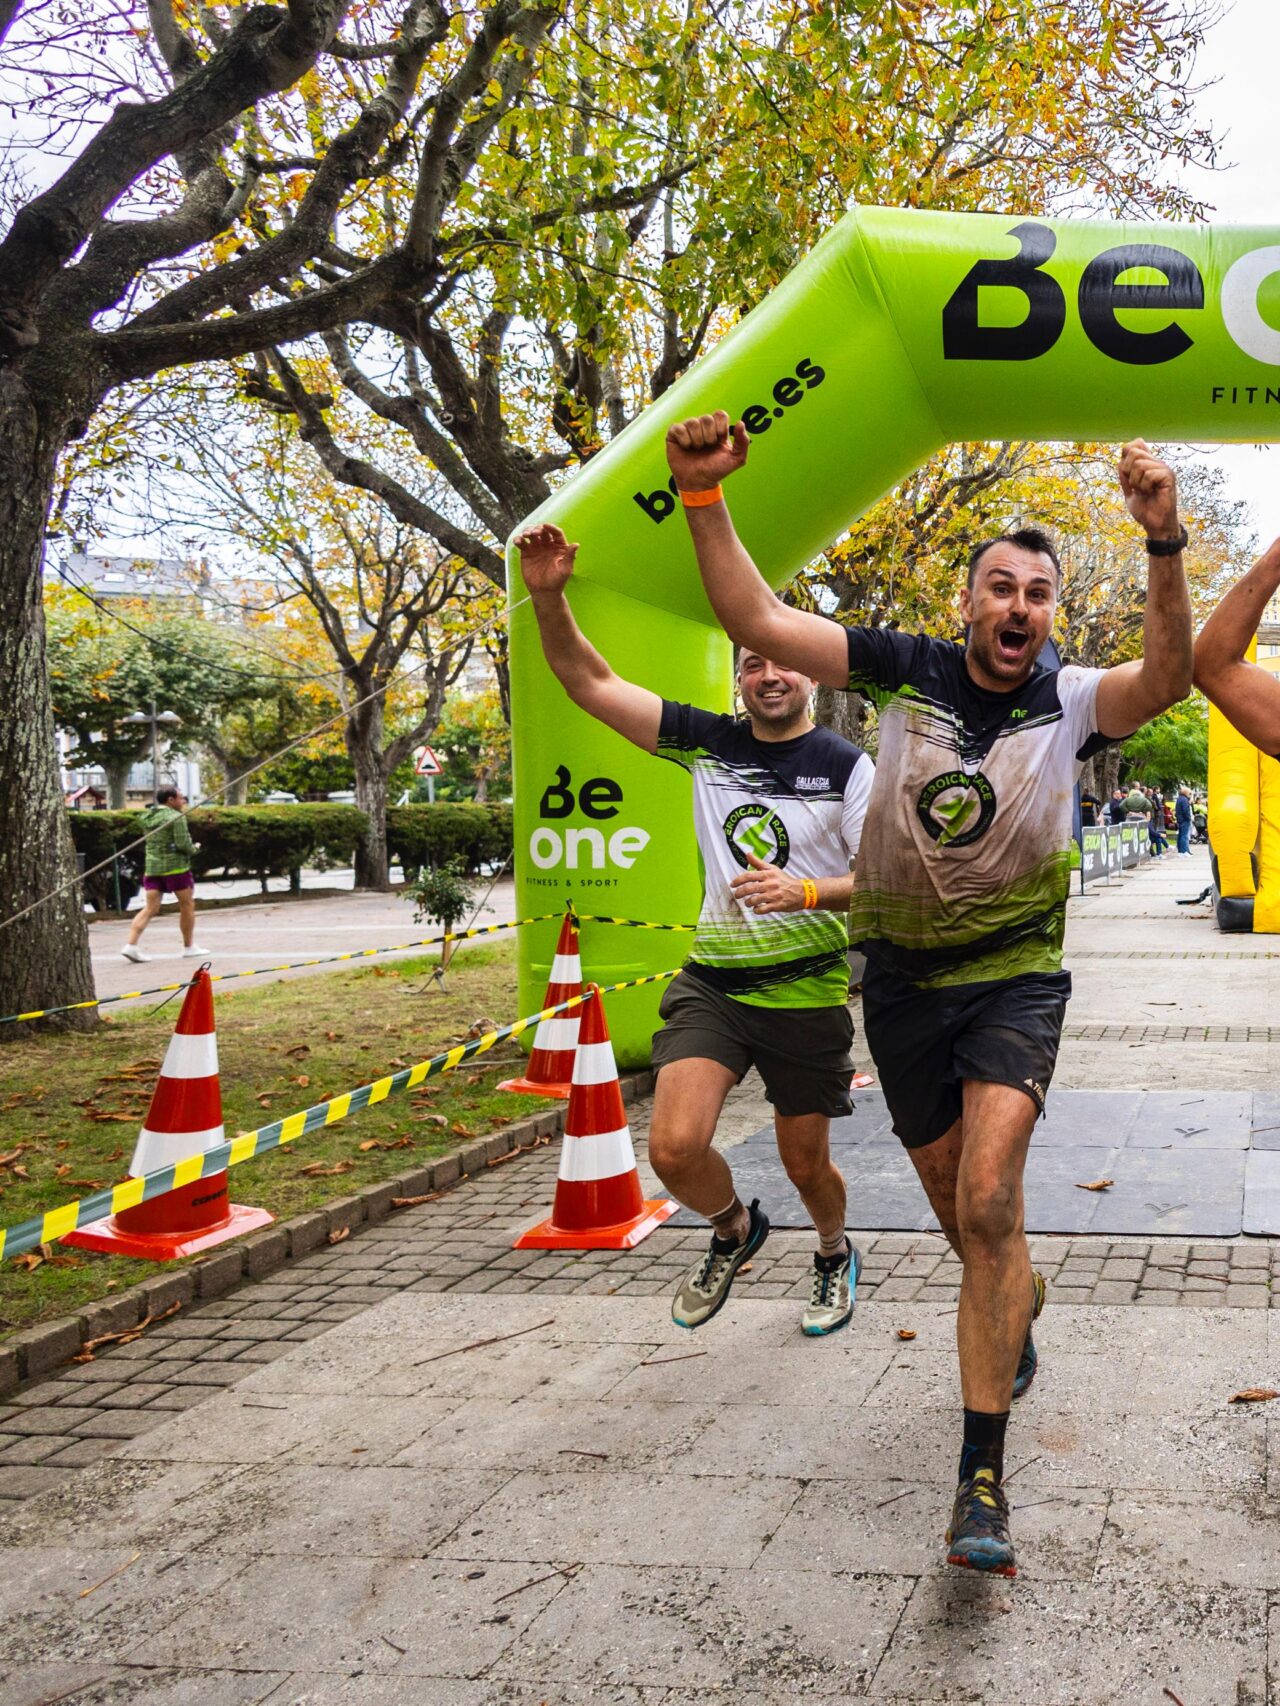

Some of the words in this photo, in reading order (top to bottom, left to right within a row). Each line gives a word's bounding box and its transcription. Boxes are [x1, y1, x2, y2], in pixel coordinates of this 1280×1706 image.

[633, 358, 826, 525] be.es
[540, 764, 624, 820] Be
[724, 806, 763, 837] EROICAN
[771, 819, 788, 847] RACE
[530, 827, 651, 869] one
[526, 876, 558, 887] FITNESS
[565, 879, 572, 887] &
[580, 879, 618, 887] SPORT
